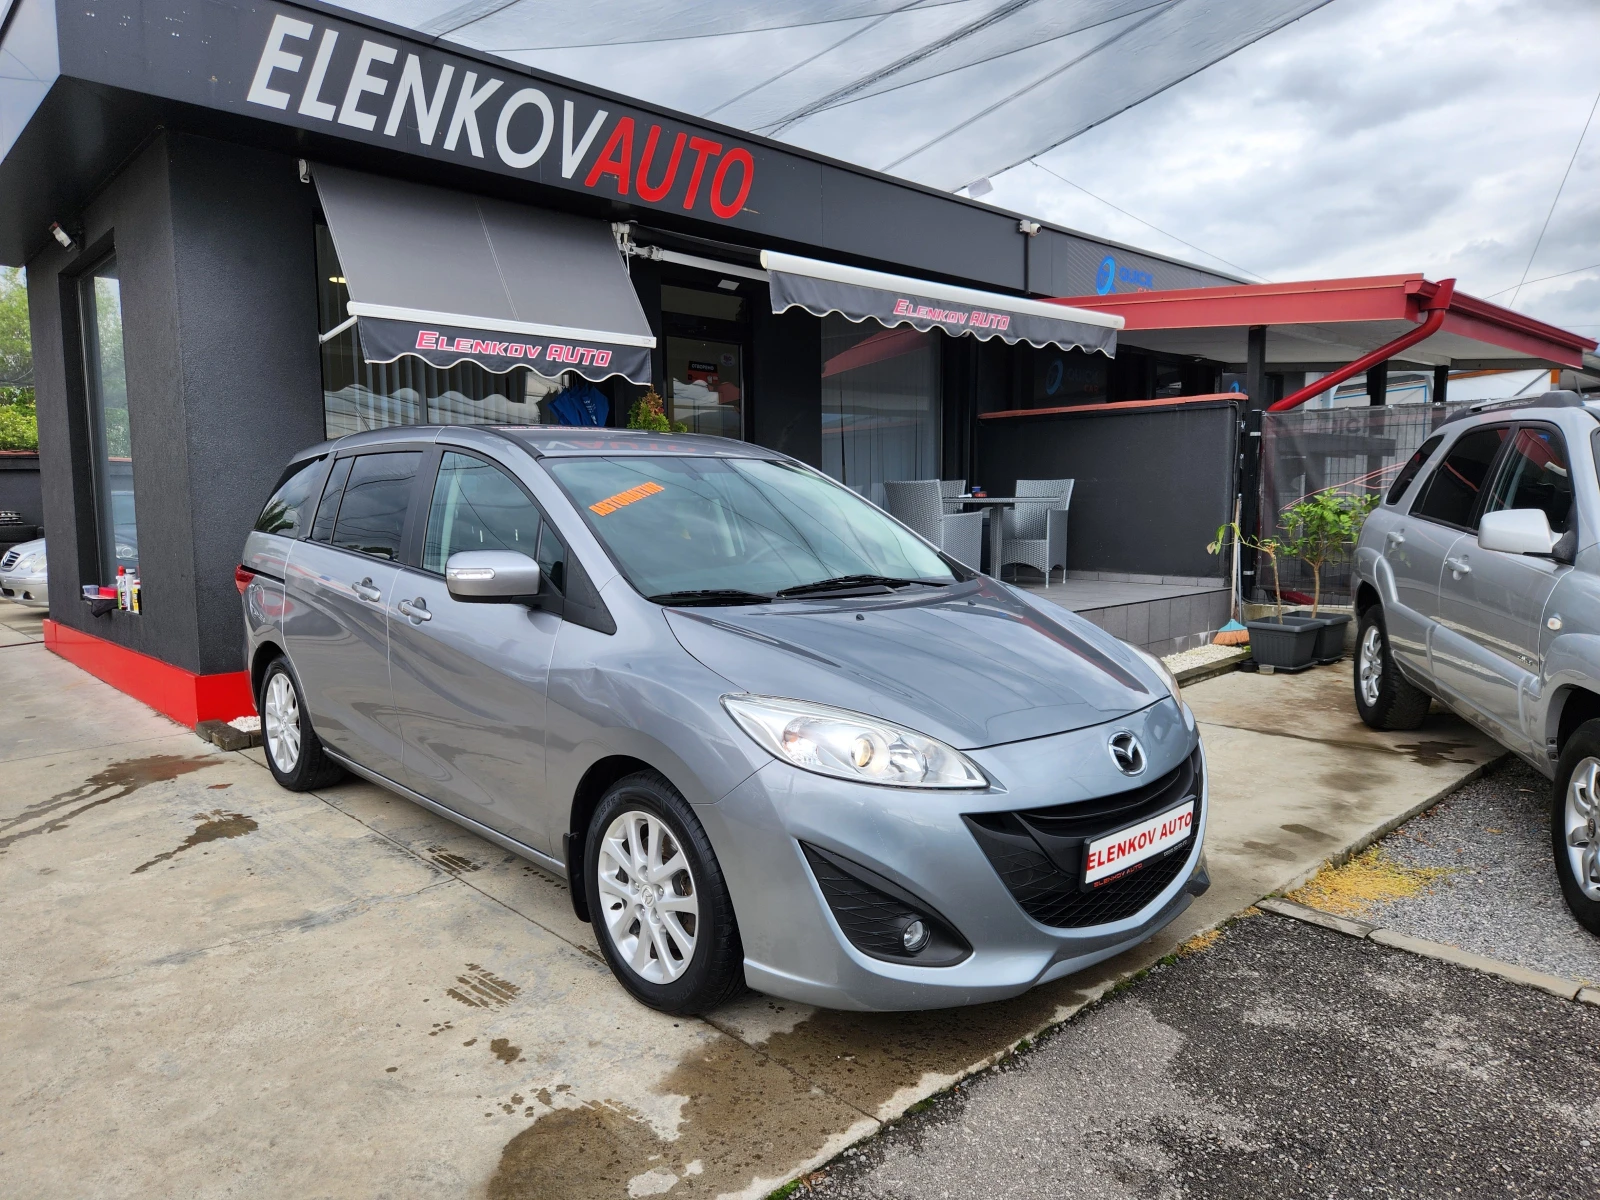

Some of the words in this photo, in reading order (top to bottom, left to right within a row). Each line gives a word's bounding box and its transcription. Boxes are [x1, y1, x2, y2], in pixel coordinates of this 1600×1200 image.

[1119, 266, 1153, 288] QUICK
[893, 299, 968, 324] ELENKOV
[970, 311, 1010, 330] AUTO
[415, 330, 542, 359] ELENKOV
[546, 344, 612, 367] AUTO
[1086, 828, 1156, 871] ELENKOV
[1160, 811, 1193, 840] AUTO
[1127, 863, 1143, 876] AUTO
